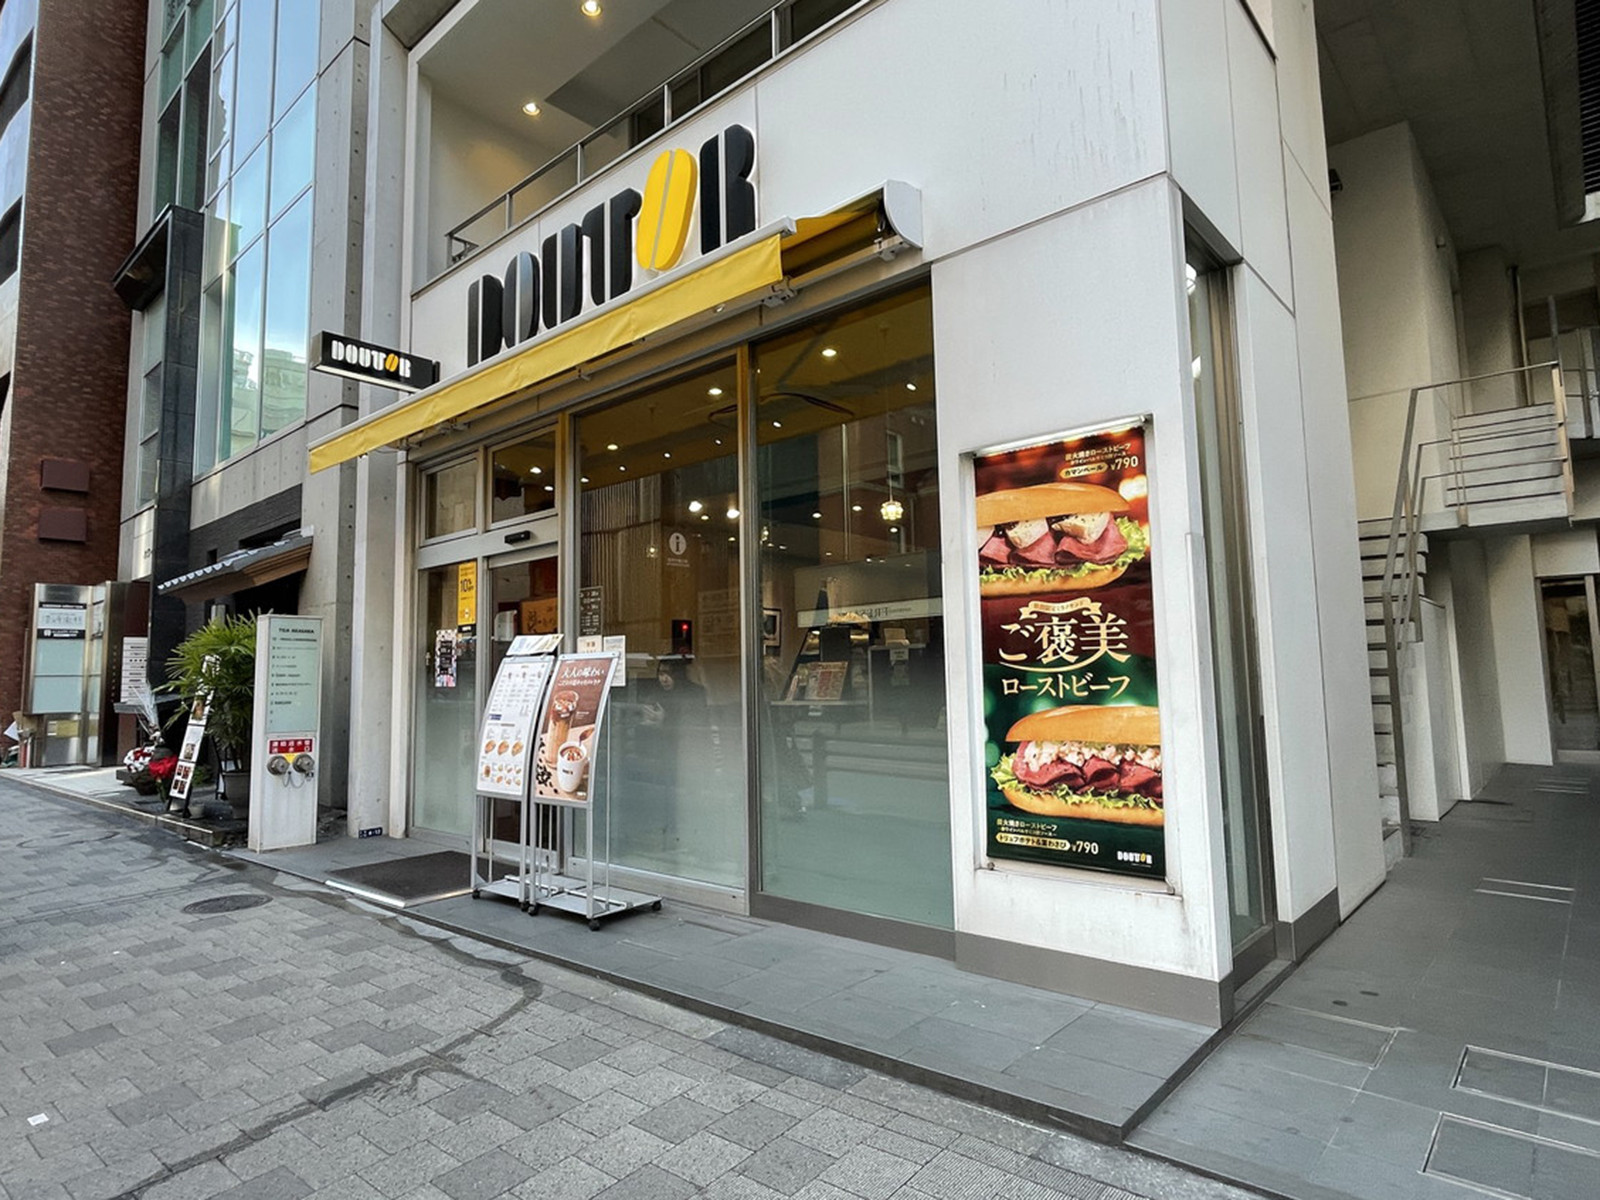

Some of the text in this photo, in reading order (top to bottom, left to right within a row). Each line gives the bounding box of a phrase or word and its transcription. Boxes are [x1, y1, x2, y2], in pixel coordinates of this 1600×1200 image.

[467, 123, 756, 368] DOUTOR
[331, 340, 411, 378] DOUTOR
[1111, 456, 1138, 470] ¥790
[999, 612, 1131, 664] ご褒美
[1001, 673, 1131, 698] ローストビーフ
[1072, 840, 1099, 854] ¥790
[1117, 851, 1152, 864] DOUTOR
